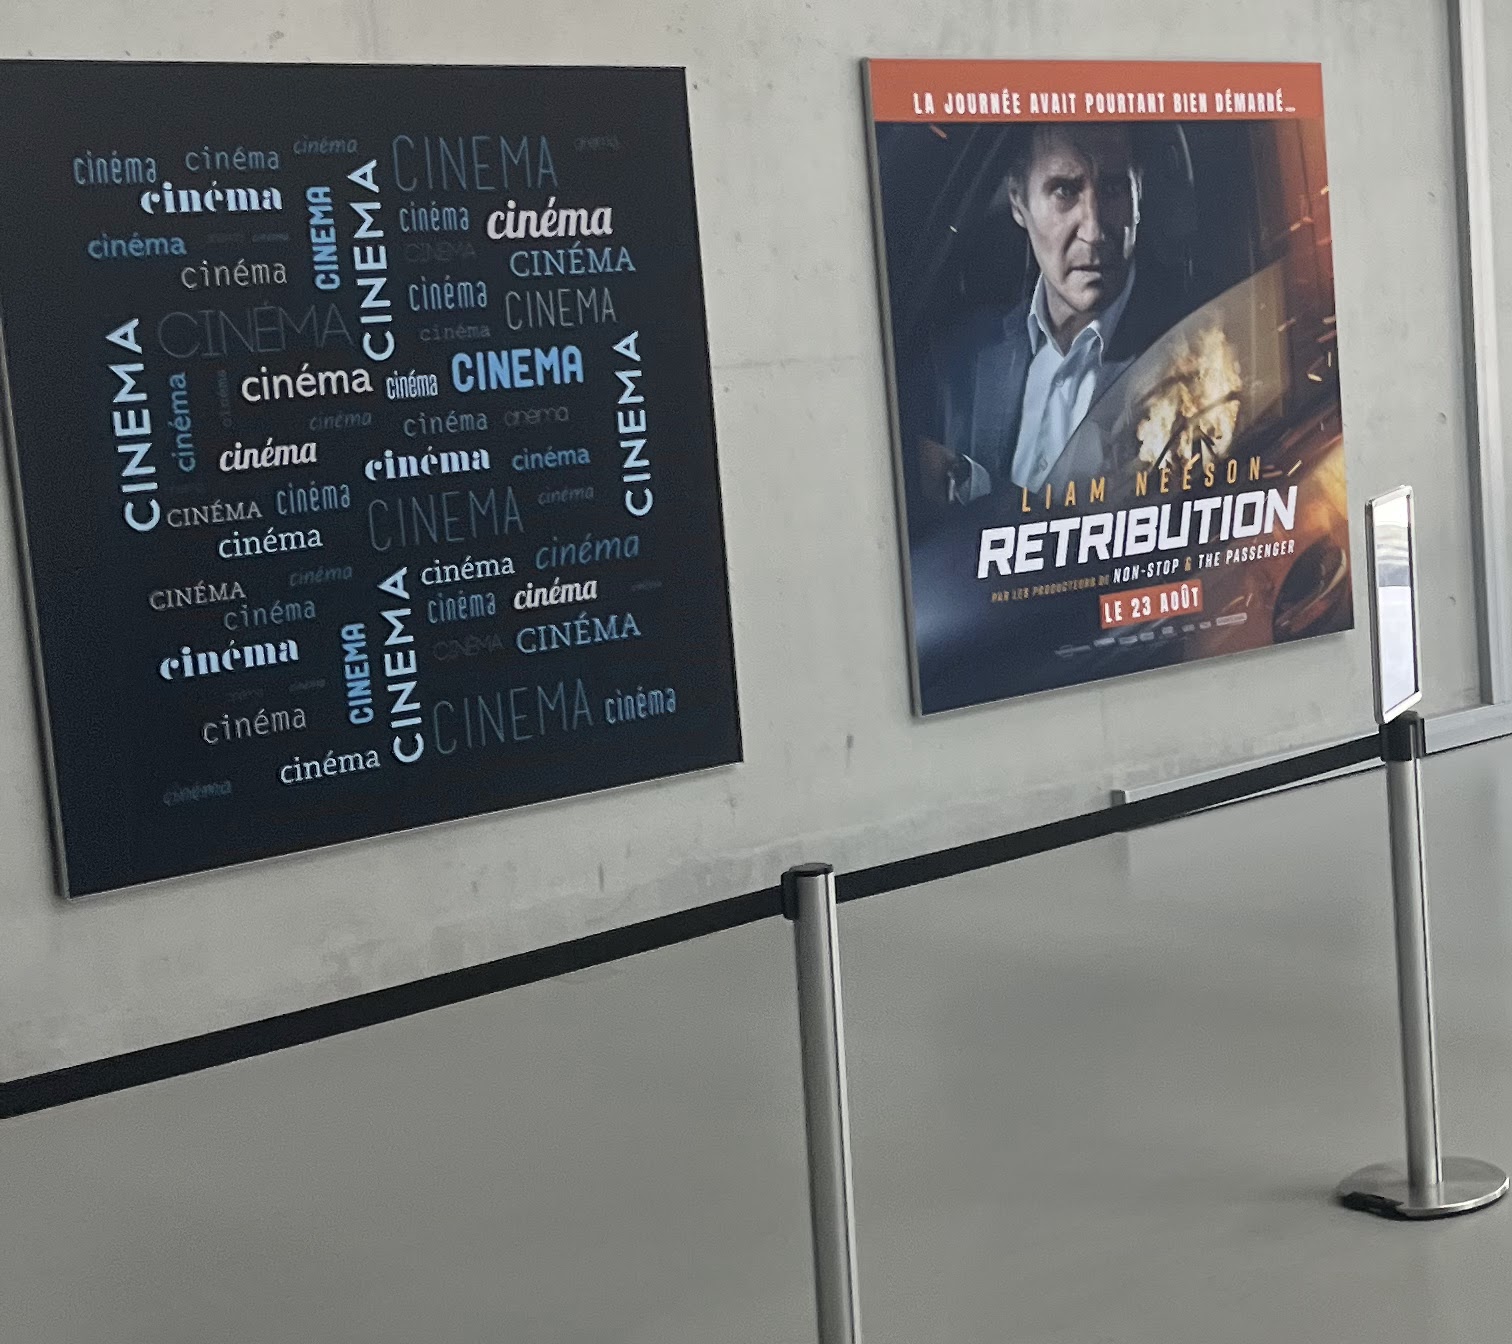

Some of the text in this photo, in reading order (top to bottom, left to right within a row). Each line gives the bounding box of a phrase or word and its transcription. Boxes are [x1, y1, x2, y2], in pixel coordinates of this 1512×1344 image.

[913, 92, 935, 115] LA
[944, 88, 1021, 114] JOURNÉE
[1030, 92, 1076, 114] AVAIT
[1085, 92, 1165, 113] POURTANT
[1172, 92, 1208, 113] BIEN
[73, 150, 157, 185] cinéma
[185, 145, 279, 172] cinéma
[391, 135, 559, 192] CINEMA
[140, 180, 283, 215] cinéma
[400, 201, 469, 233] cinéma
[487, 196, 614, 240] cinéma
[87, 232, 187, 260] cinéma
[305, 186, 341, 290] CINEMA
[181, 259, 287, 290] cinéma
[347, 159, 396, 362] CINEMA
[509, 240, 636, 278] CINÉMA
[409, 276, 488, 312] cinéma
[504, 287, 618, 331] CINEMA
[241, 363, 373, 403] cinéma
[386, 370, 438, 401] cinéma
[451, 345, 584, 393] CINEMA
[105, 318, 161, 532] CINEMA
[169, 372, 197, 472] cinéma
[404, 410, 488, 438] cinéma
[612, 330, 653, 517] CINEMA
[219, 437, 317, 472] cinéma
[365, 446, 491, 481] cinéma
[511, 445, 591, 472] cinéma
[275, 480, 351, 516] cinéma
[1022, 456, 1262, 513] LIAM NEESON
[166, 499, 263, 528] CINÉMA
[368, 486, 524, 552] CINEMA
[977, 485, 1298, 579] RETRIBUTION
[218, 527, 324, 559] cinéma
[535, 532, 640, 571] cinéma
[1113, 558, 1179, 585] NON-STOP
[1198, 550, 1220, 570] THE
[1225, 539, 1295, 565] PASSENGER
[421, 556, 515, 586] cinéma
[150, 580, 247, 612] CINÉMA
[428, 590, 497, 624] cinéma
[513, 576, 598, 611] cinéma
[1103, 583, 1200, 624] LE 23 AOÛT
[223, 599, 316, 631] cinéma
[516, 611, 641, 655] CINÉMA
[159, 639, 299, 680] cinéma
[341, 622, 374, 725] CINEMA
[376, 566, 425, 764] CINEMA
[432, 678, 594, 755] CINEMA
[604, 685, 677, 725] cinéma
[202, 707, 307, 745] cinéma
[279, 749, 381, 785] cinéma
